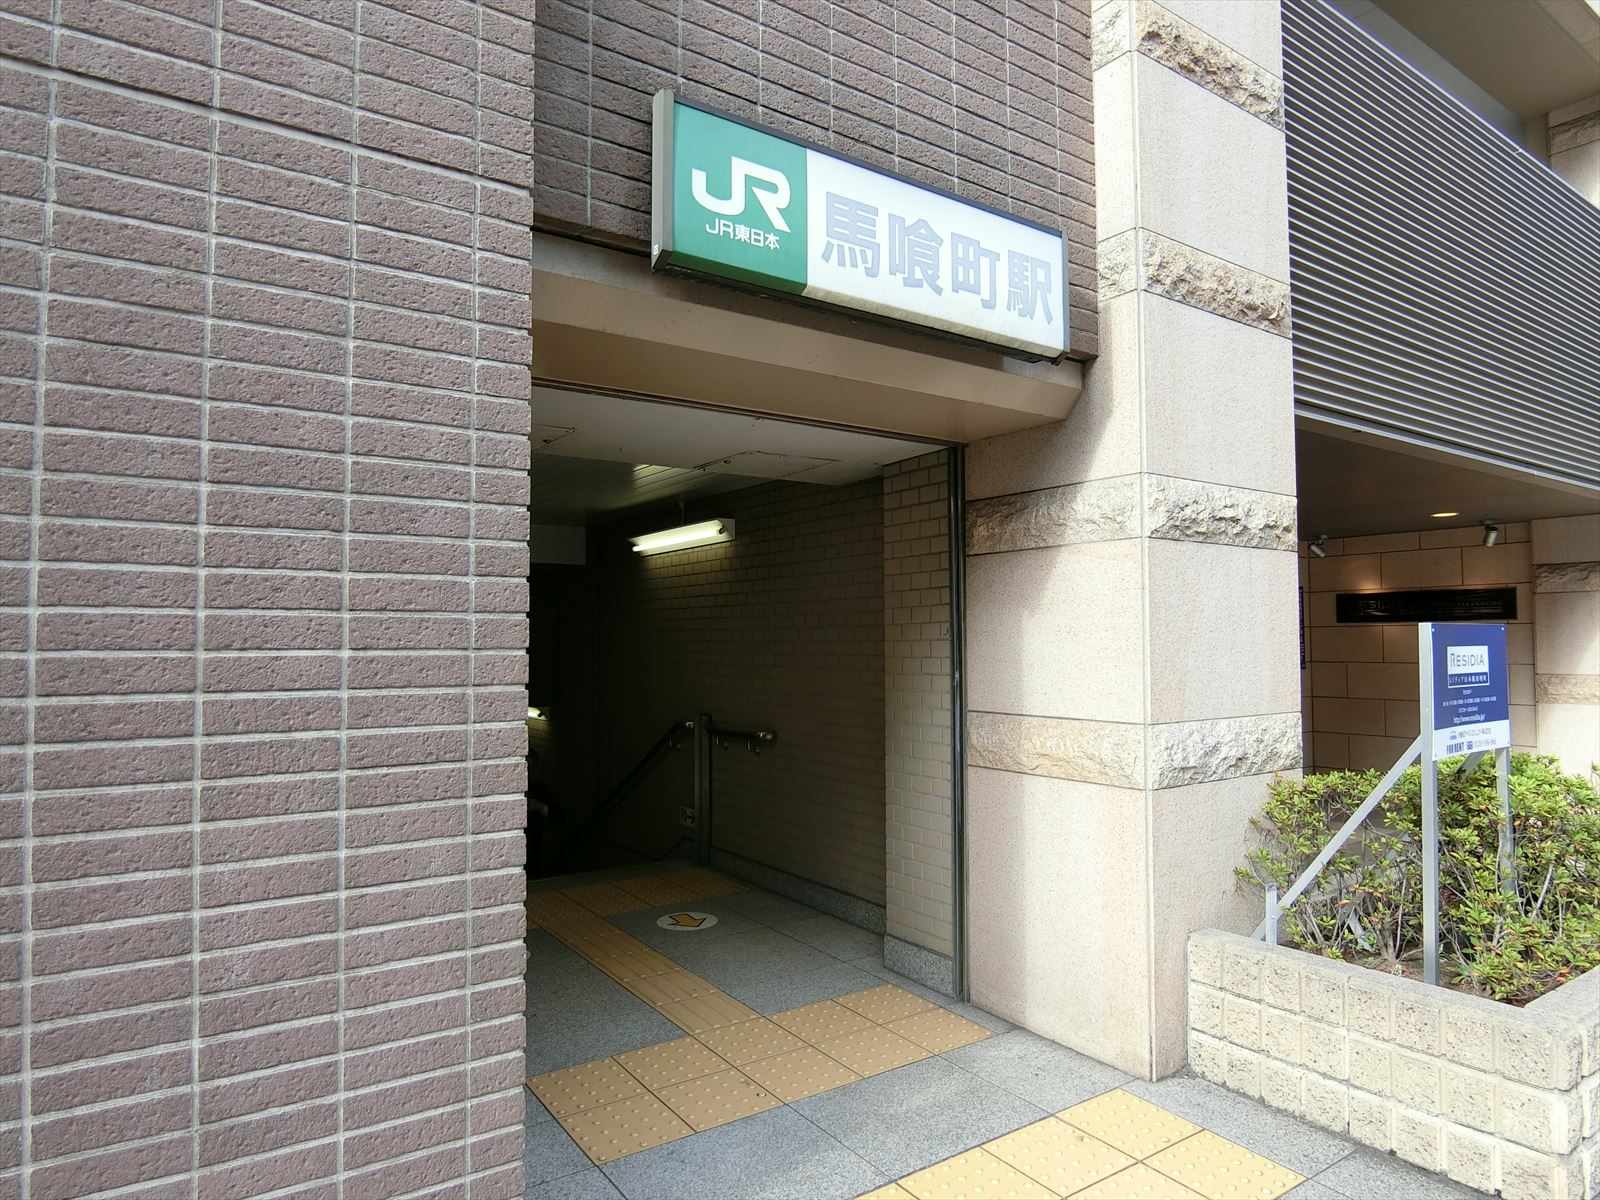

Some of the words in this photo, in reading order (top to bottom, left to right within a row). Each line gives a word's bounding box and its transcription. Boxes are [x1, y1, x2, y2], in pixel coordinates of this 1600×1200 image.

[691, 156, 791, 233] JR
[705, 217, 780, 250] JR東日本
[821, 191, 1054, 326] 馬喰町駅
[1450, 653, 1485, 667] RESIDIA
